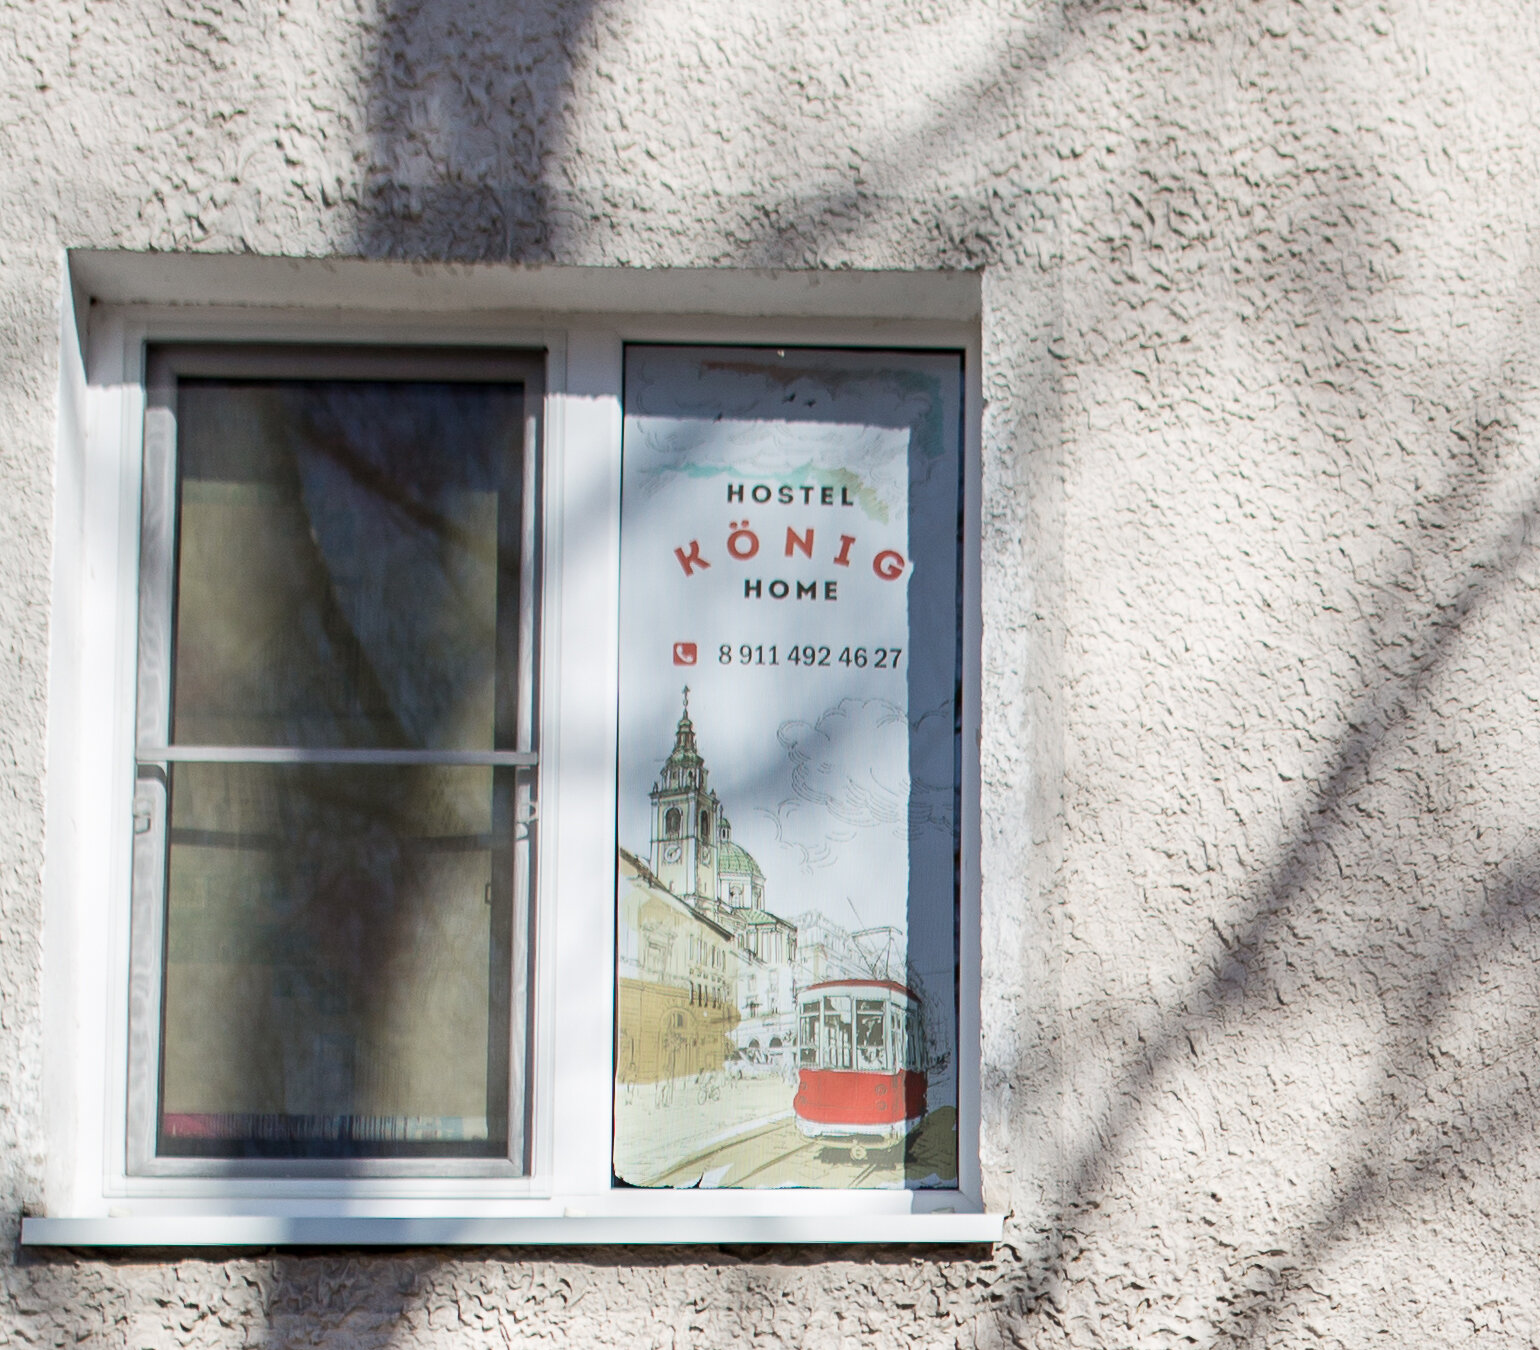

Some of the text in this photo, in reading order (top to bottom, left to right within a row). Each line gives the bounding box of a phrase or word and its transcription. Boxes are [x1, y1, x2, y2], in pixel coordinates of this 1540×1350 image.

[726, 483, 855, 507] HOSTEL
[674, 519, 906, 582] KÖNIG
[743, 579, 839, 602] HOME
[718, 644, 903, 669] 8 911 492 46 27
